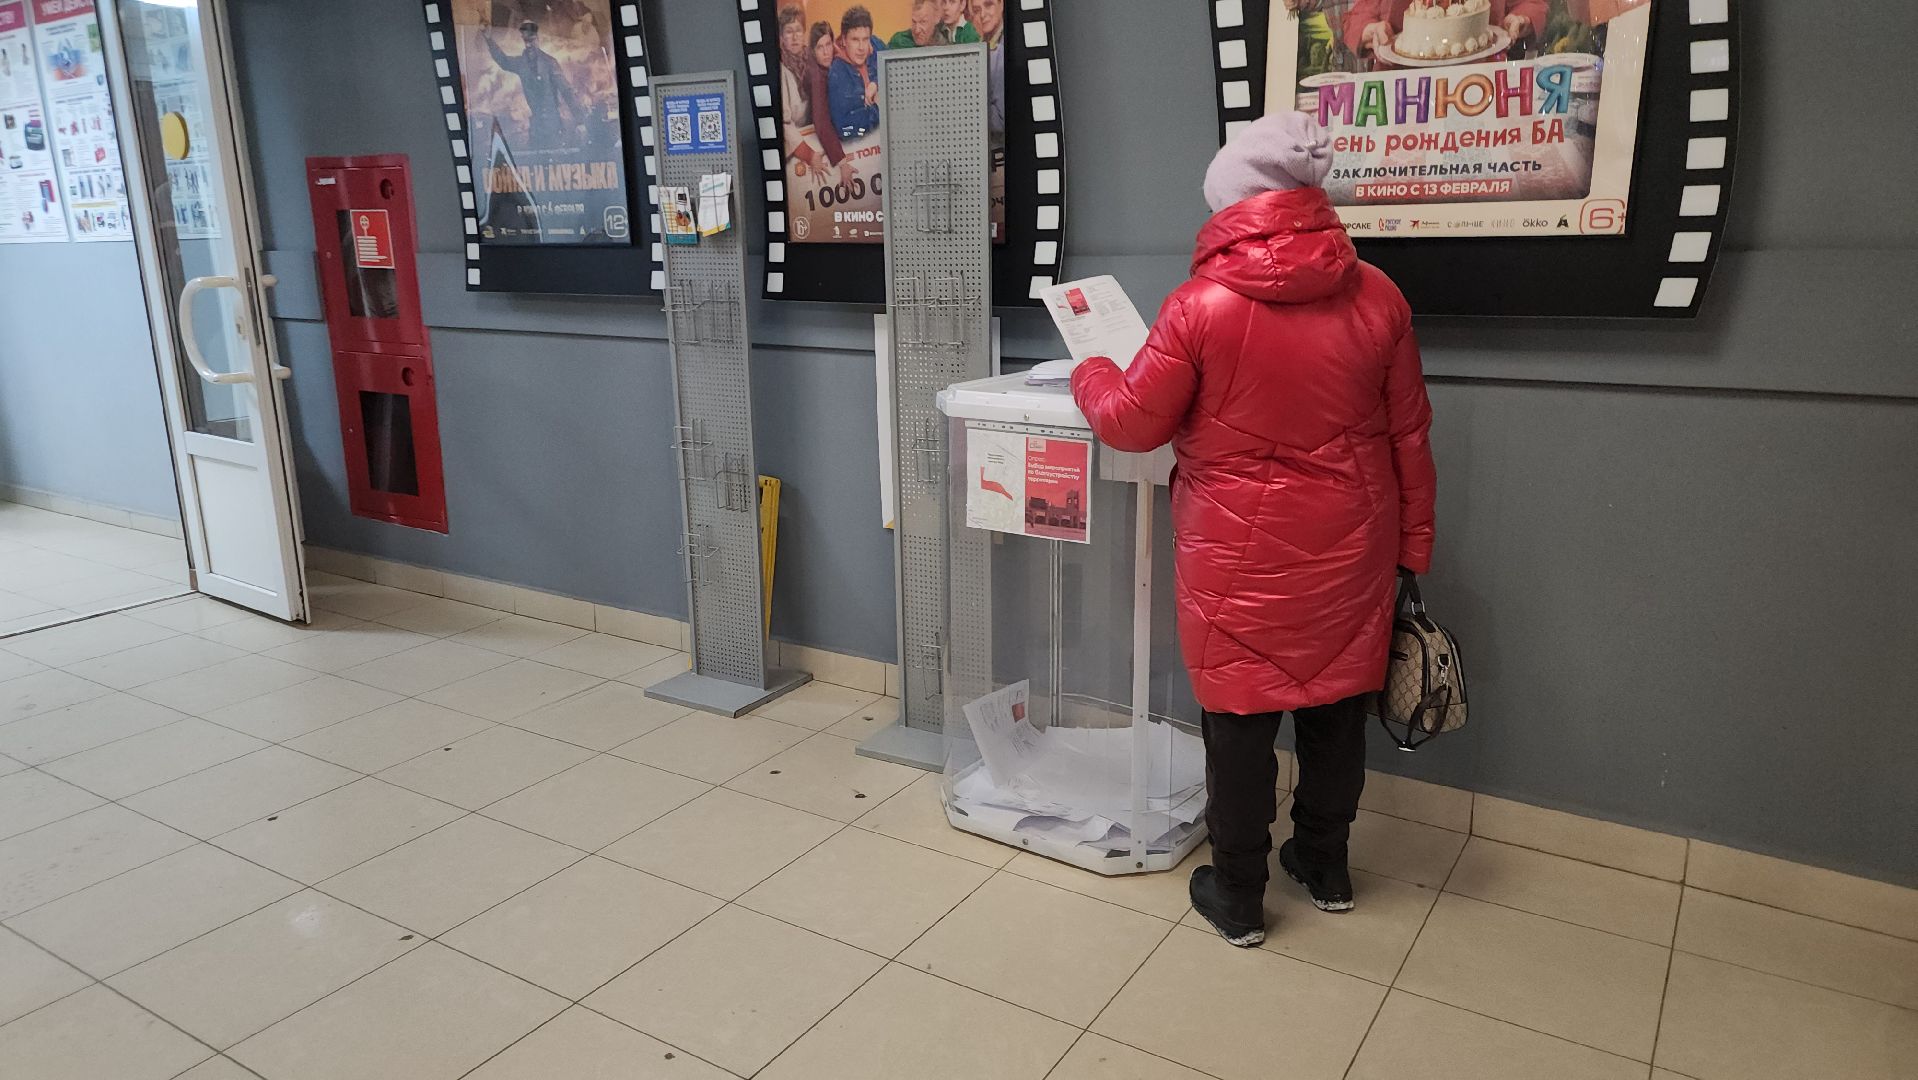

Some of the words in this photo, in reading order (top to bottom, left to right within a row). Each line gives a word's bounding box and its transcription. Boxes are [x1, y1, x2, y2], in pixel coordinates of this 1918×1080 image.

[1317, 64, 1573, 127] МАНЮНЯ
[1333, 134, 1376, 153] ень
[1384, 128, 1521, 156] рождения
[1531, 118, 1565, 145] БА
[1332, 164, 1483, 180] ЗАКЛЮЧИТЕЛЬНАЯ
[1487, 160, 1543, 174] ЧАСТЬ
[1355, 186, 1364, 198] В
[1366, 184, 1408, 197] КИНО
[1410, 184, 1420, 196] С
[1423, 183, 1437, 196] 13
[1439, 180, 1510, 195] ФЕВРАЛЯ
[834, 211, 843, 223] В
[844, 211, 875, 223] КИНО
